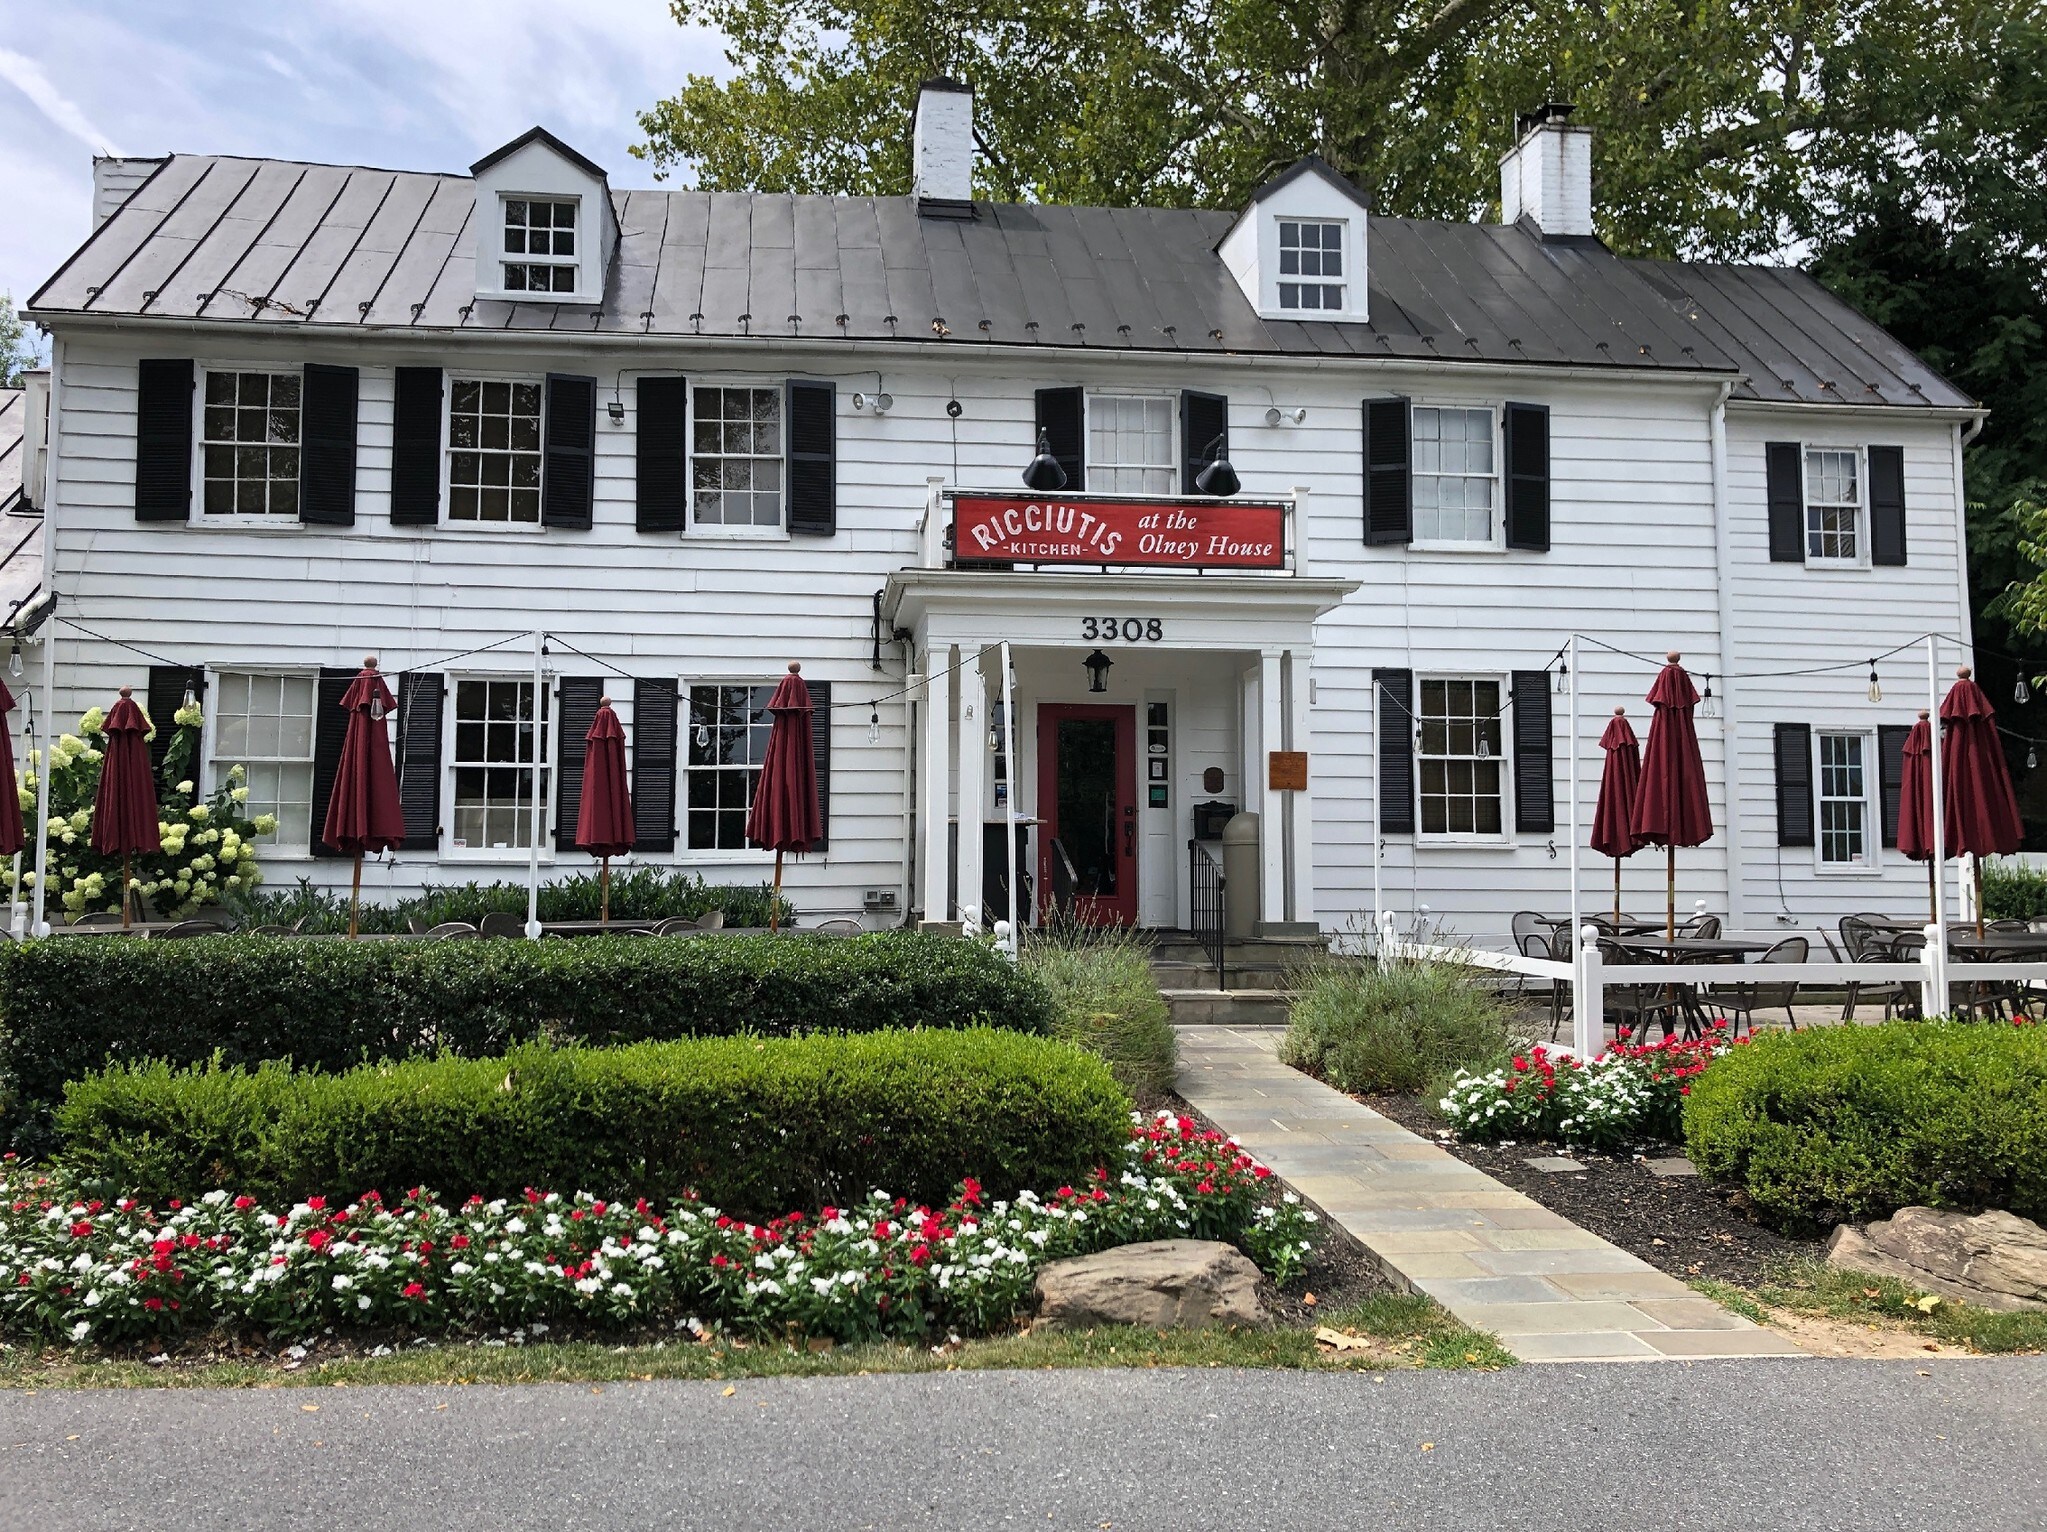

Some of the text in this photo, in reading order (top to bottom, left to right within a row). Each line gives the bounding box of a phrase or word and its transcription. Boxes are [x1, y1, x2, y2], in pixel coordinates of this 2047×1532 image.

[970, 504, 1122, 556] RICCIUTIS
[1138, 509, 1197, 530] at the
[1138, 533, 1273, 560] Olney House
[1081, 617, 1164, 642] 3308
